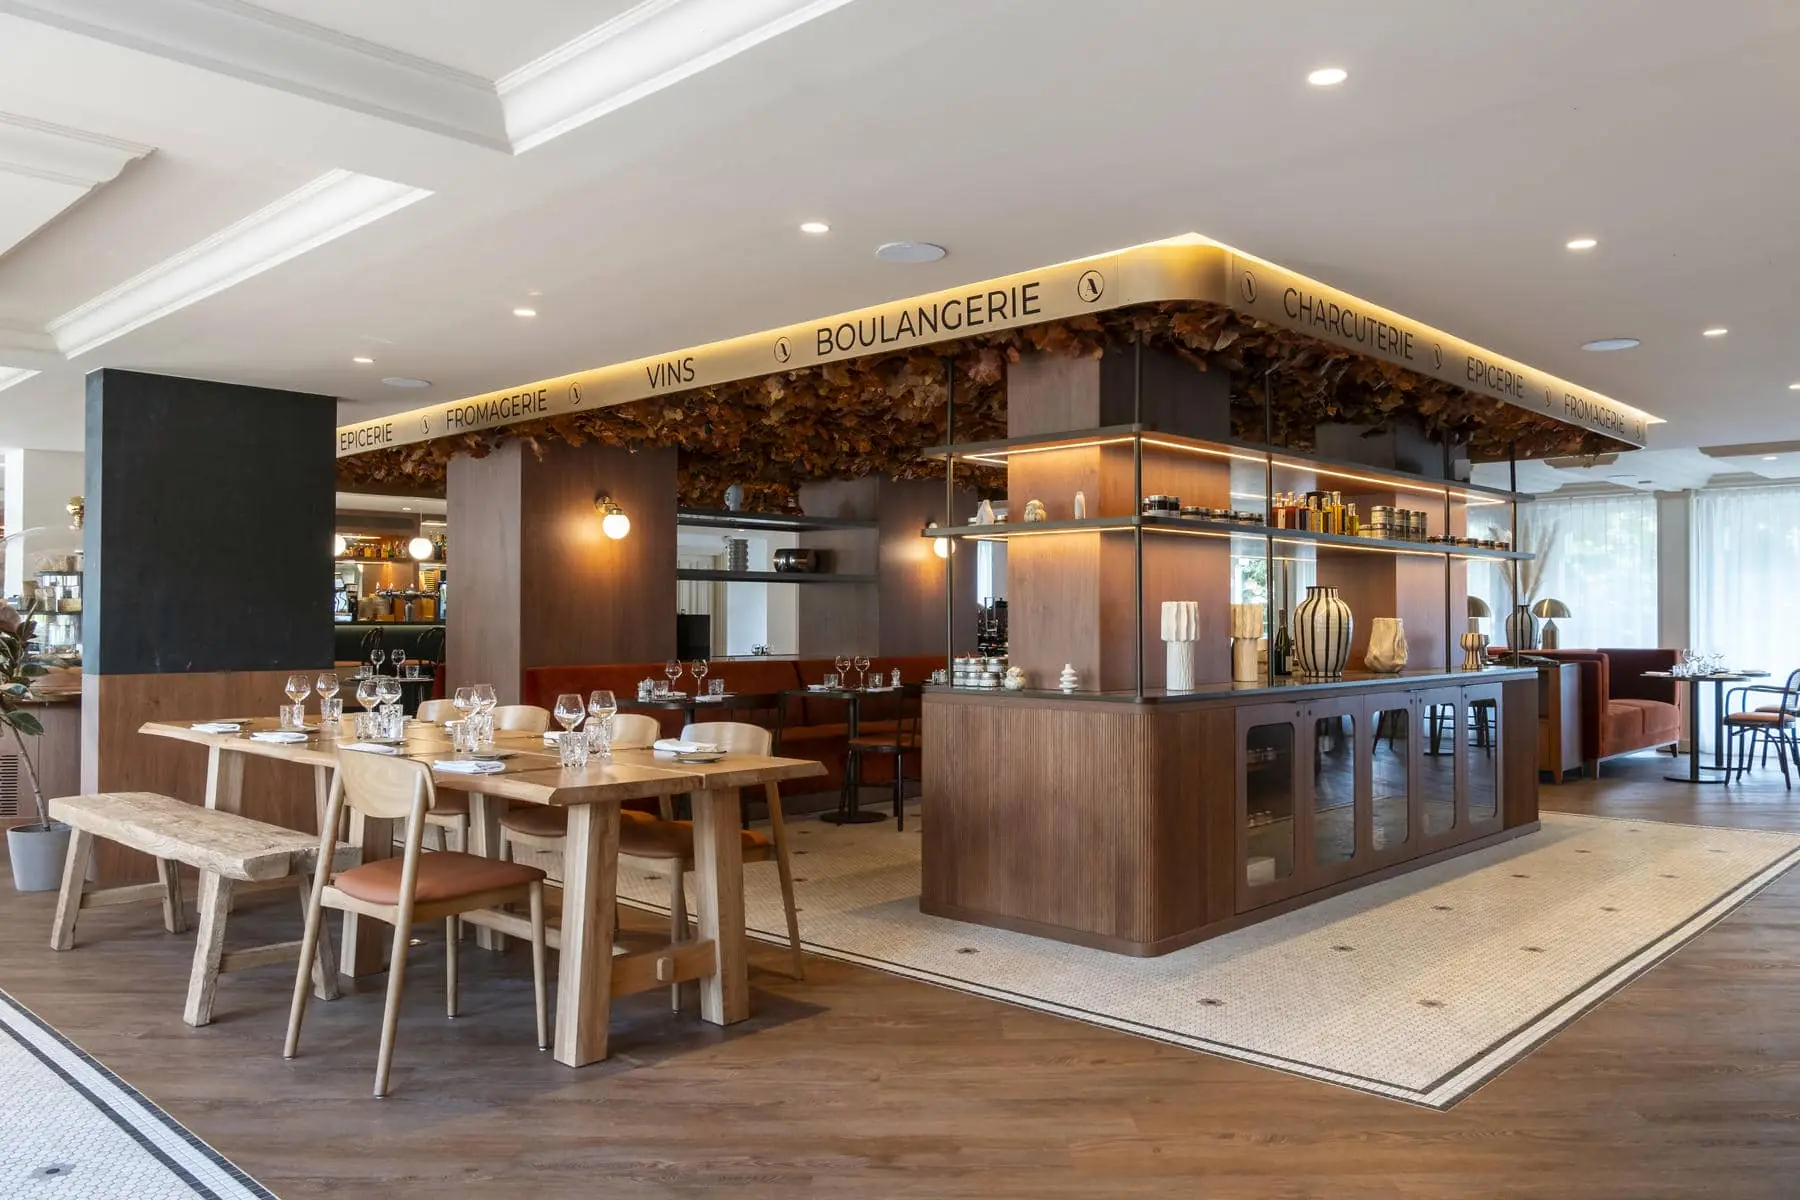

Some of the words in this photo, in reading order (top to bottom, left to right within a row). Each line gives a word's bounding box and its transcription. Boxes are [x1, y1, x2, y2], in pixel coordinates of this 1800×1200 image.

[816, 282, 1041, 356] BOULANGERIE
[1283, 287, 1414, 360] CHARCUTERIE
[646, 357, 695, 388] VINS
[1467, 355, 1524, 399] EPICERIE
[446, 389, 547, 430] FROMAGERIE
[1564, 393, 1625, 434] FROMAGERIE
[340, 422, 393, 450] EPICERIE
